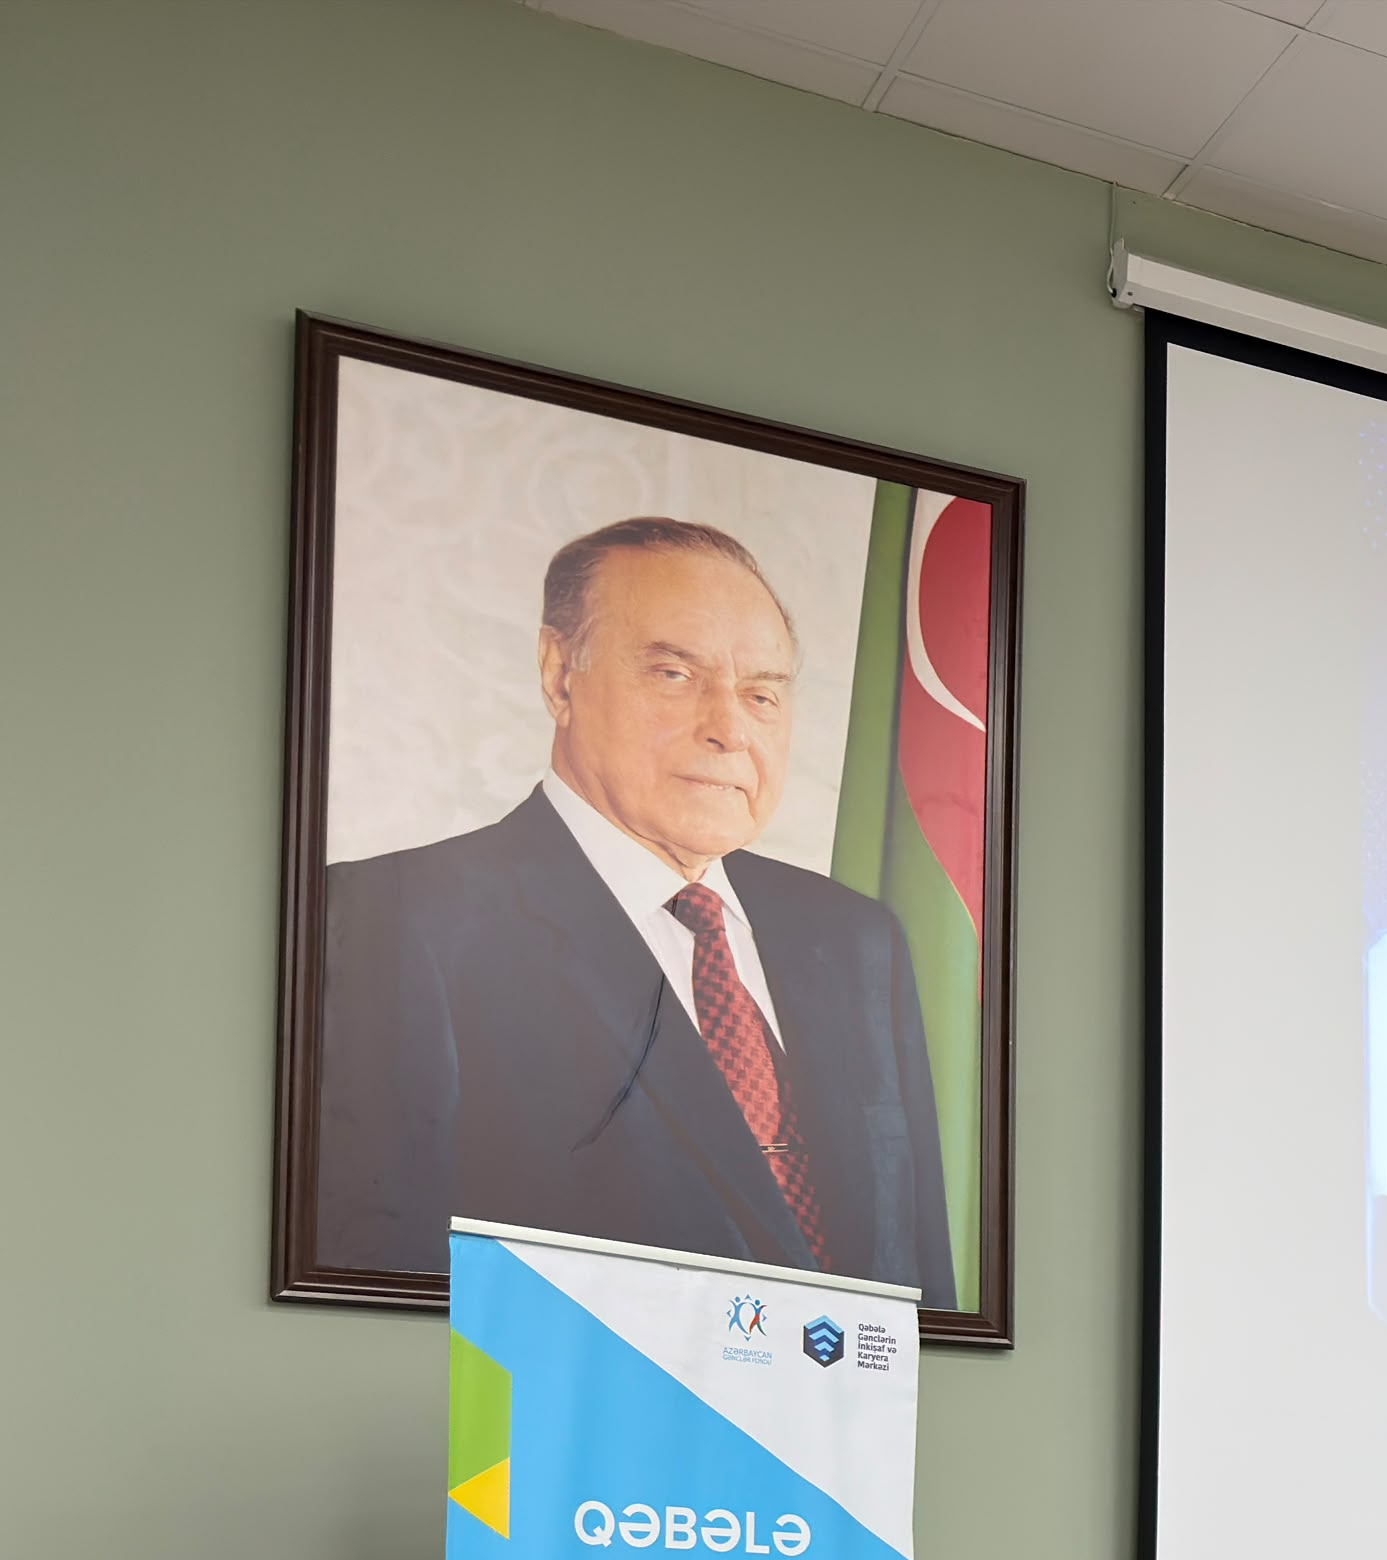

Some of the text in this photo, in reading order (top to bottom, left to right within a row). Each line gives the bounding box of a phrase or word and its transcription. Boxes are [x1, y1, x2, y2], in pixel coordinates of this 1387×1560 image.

[858, 1323, 886, 1334] Qəbələ
[857, 1333, 897, 1345] Gənclərin
[723, 1347, 773, 1359] AZƏRBAYCAN
[857, 1340, 897, 1354] İnkişaf və
[857, 1352, 889, 1364] Karyera
[857, 1361, 889, 1371] Mərkəzi
[574, 1500, 812, 1557] QƏBƏLƏ
